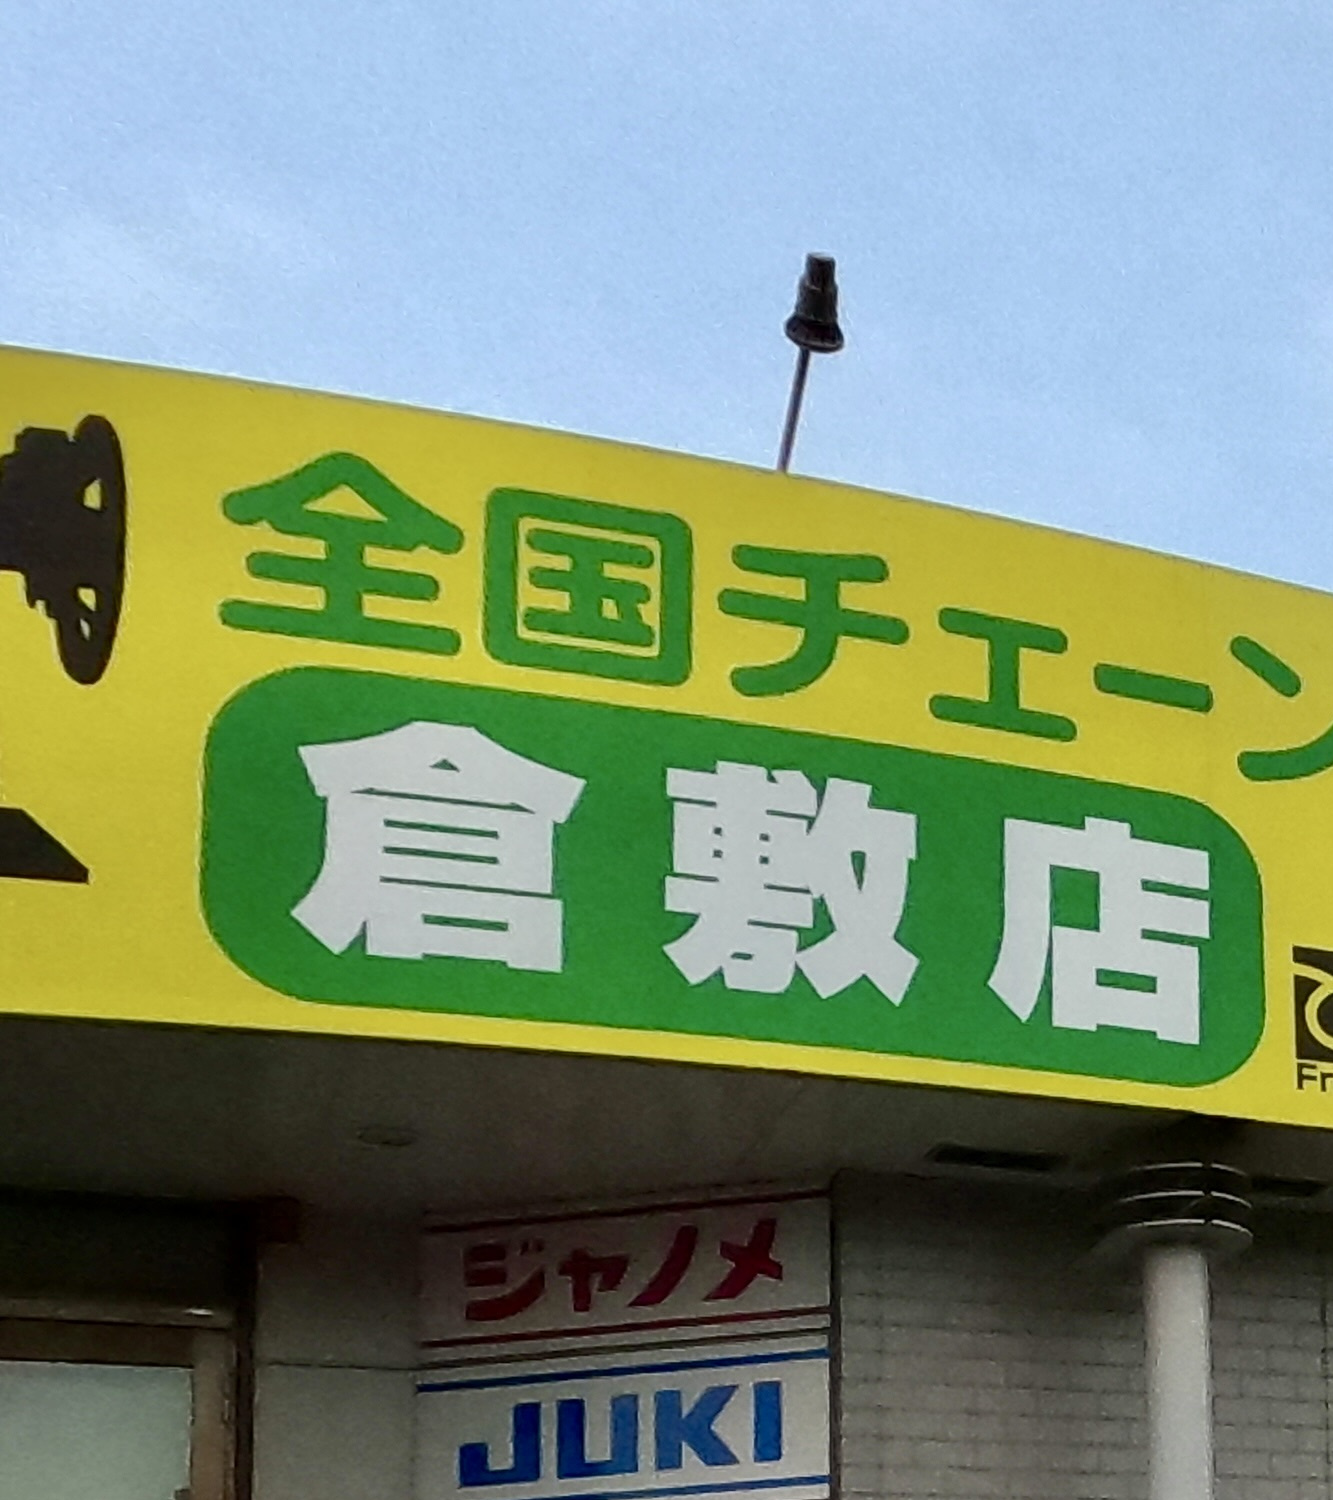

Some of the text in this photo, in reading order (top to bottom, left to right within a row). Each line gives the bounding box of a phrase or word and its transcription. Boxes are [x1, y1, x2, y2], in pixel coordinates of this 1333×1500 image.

[291, 719, 1211, 1046] 倉敷店
[464, 1217, 784, 1322] ジャノメ
[458, 1380, 783, 1489] JUKI
